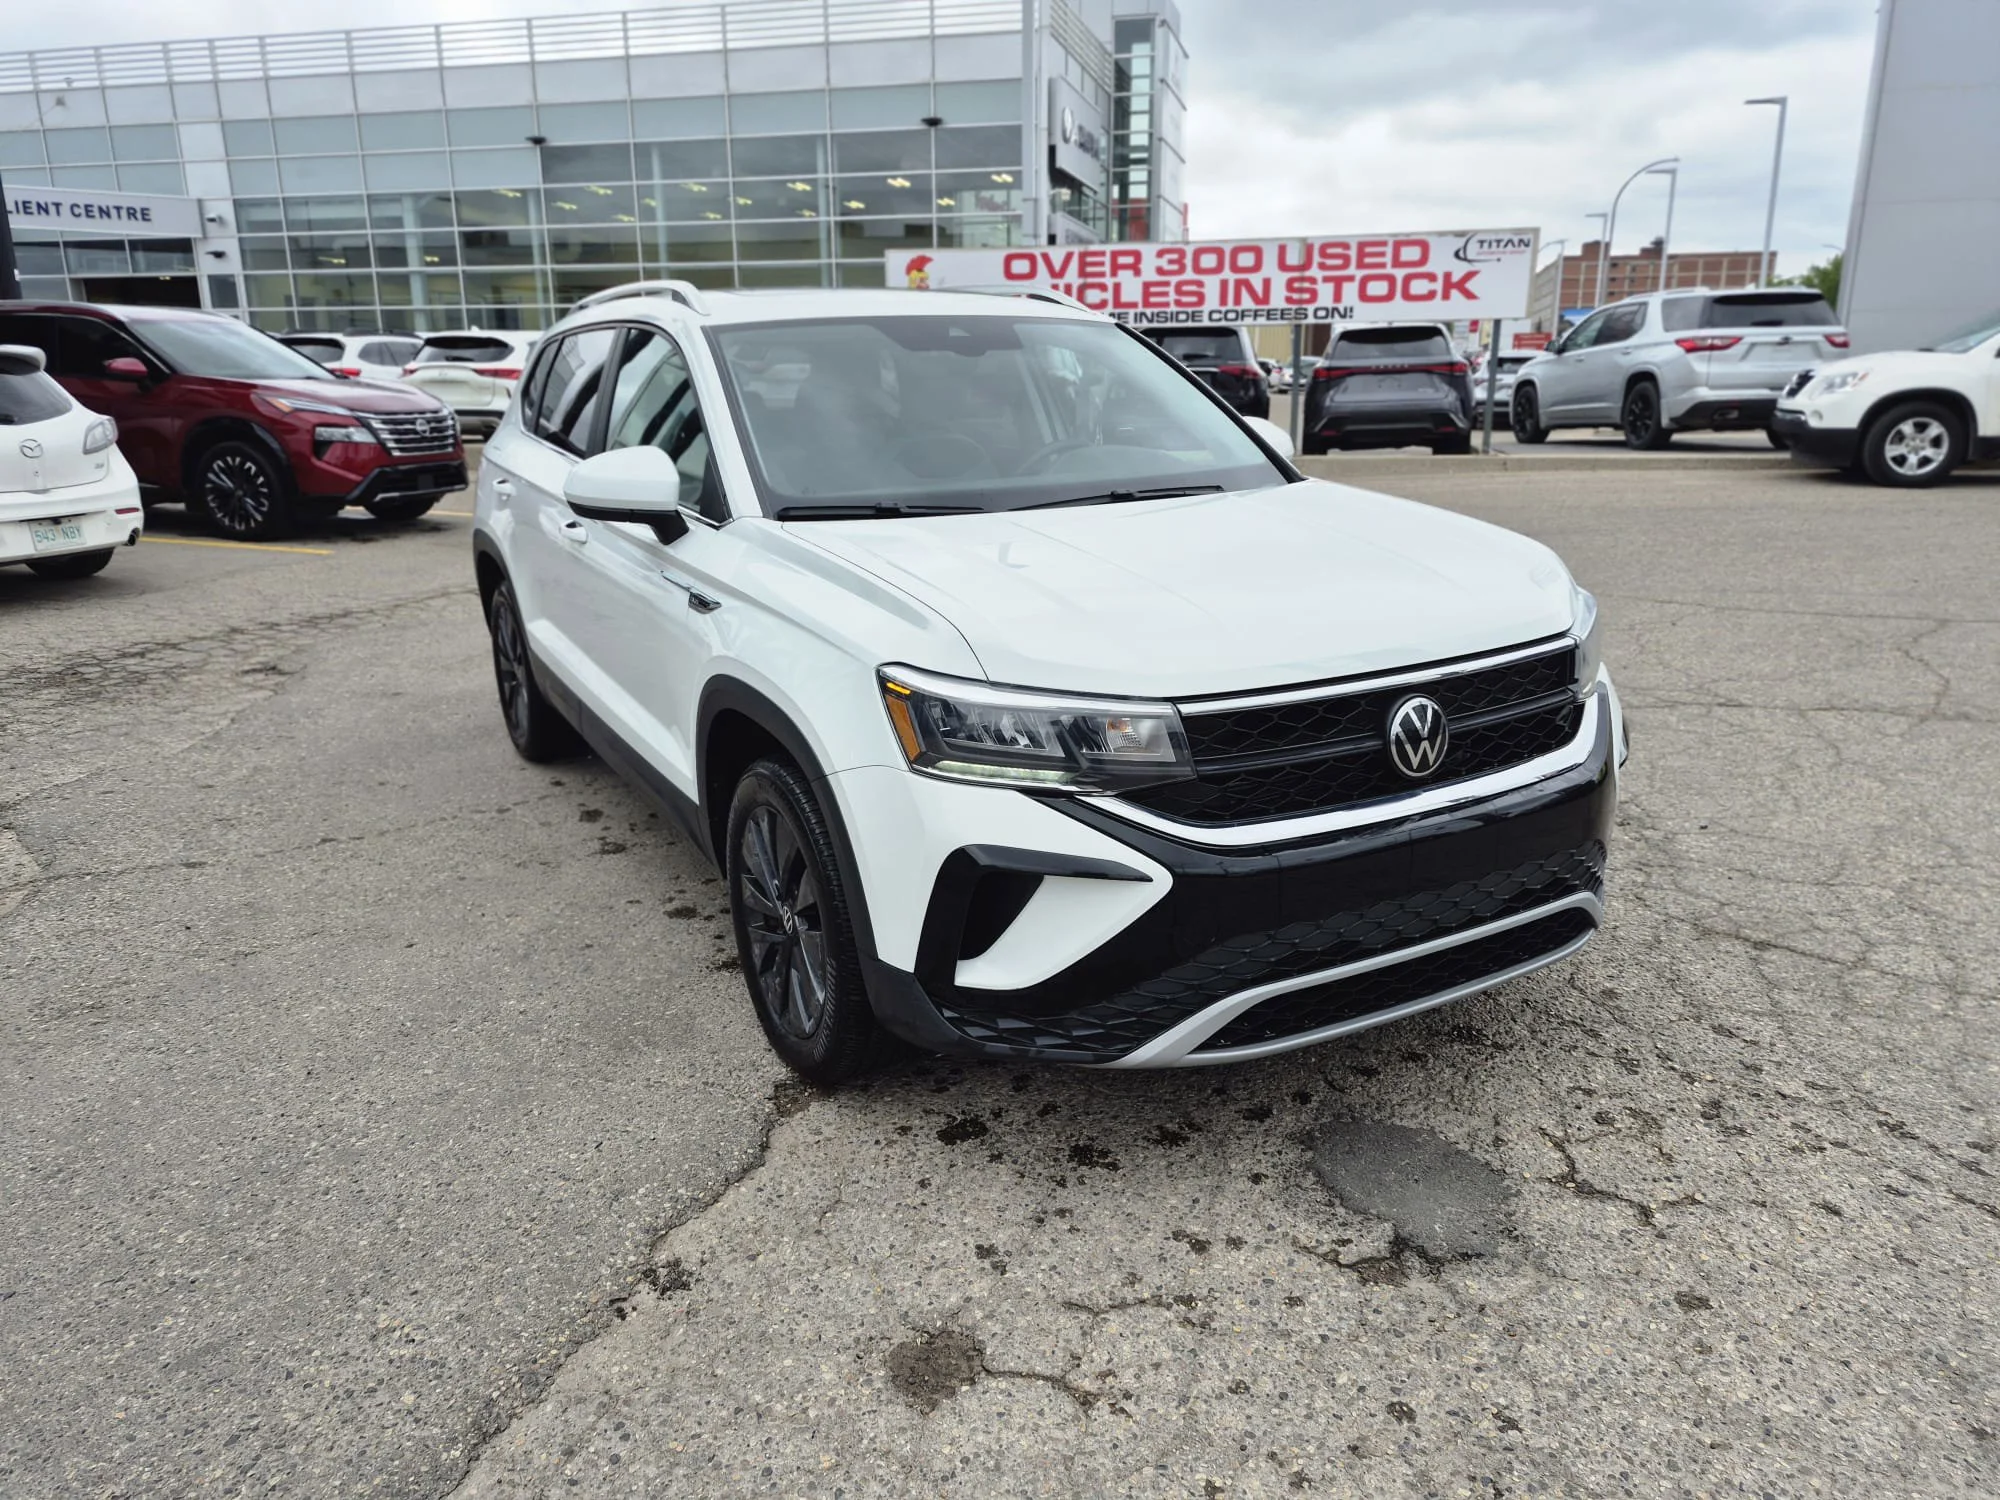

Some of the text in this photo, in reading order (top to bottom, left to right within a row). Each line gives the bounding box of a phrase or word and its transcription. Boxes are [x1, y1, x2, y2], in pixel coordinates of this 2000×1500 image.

[70, 203, 152, 222] CENTRE
[1477, 237, 1531, 249] TITAN
[1003, 239, 1431, 280] OVER 300 USED
[1219, 277, 1271, 307] IN
[1284, 271, 1481, 305] STOCK
[1133, 311, 1203, 324] INSIDE
[1208, 307, 1309, 323] COFFEES
[1313, 306, 1354, 320] ON!
